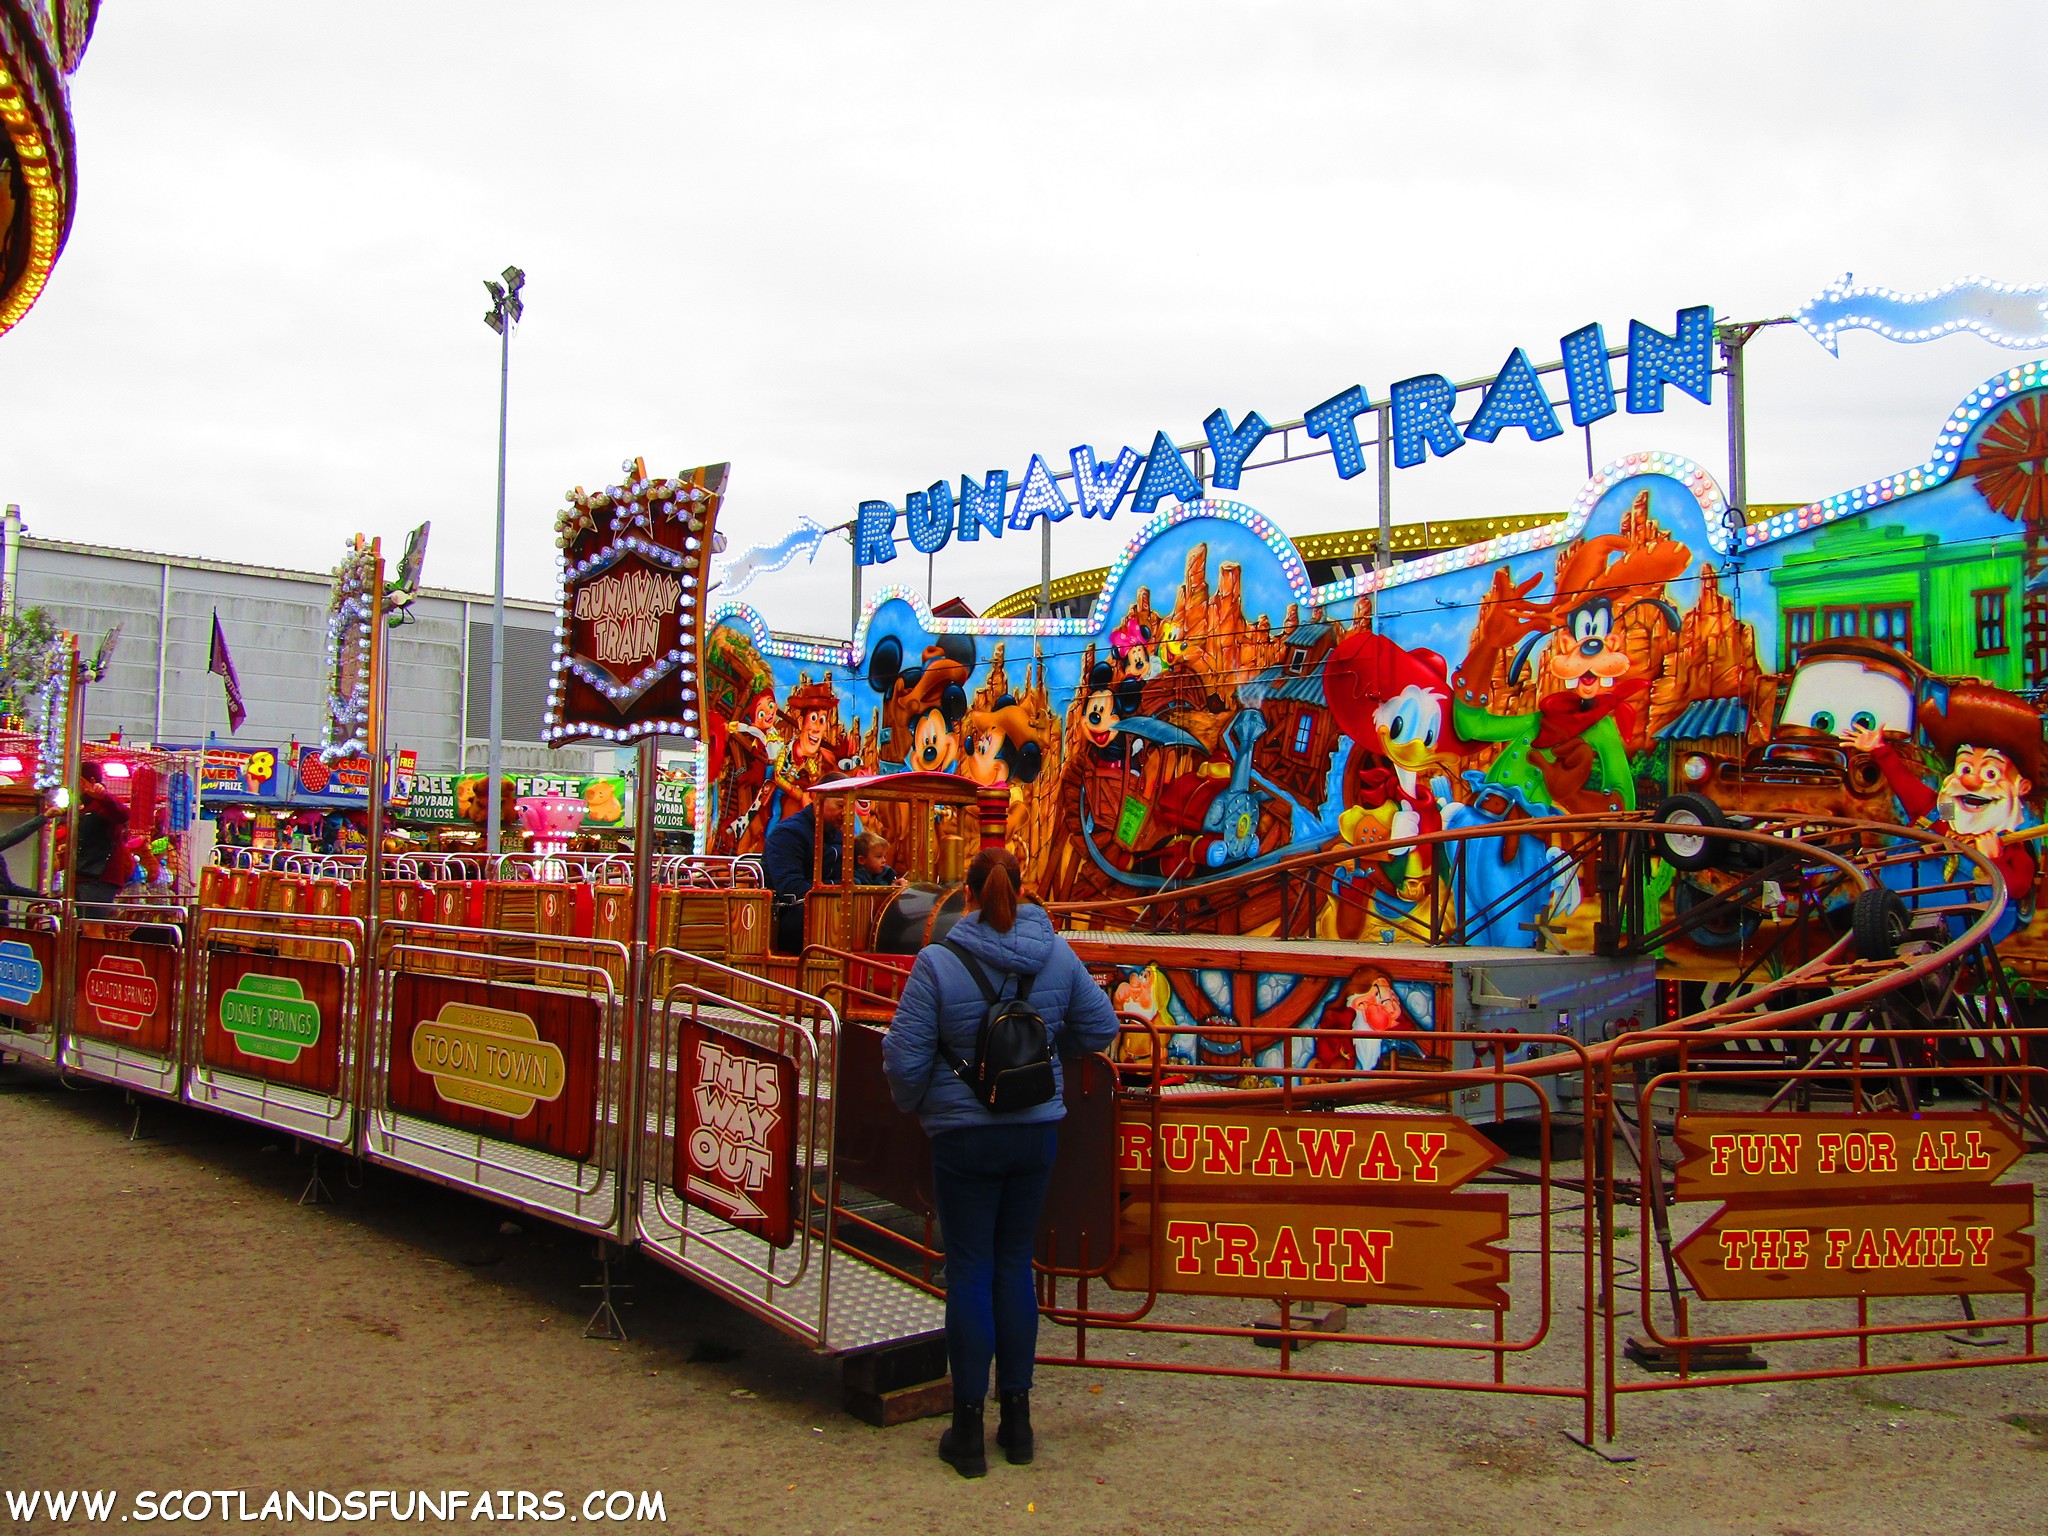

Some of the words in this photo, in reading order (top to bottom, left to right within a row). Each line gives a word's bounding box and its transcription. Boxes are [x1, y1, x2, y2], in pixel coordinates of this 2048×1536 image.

[857, 407, 1272, 566] RUNAWAY
[1304, 304, 1714, 480] TRAIN
[575, 569, 681, 621] RUNAWAY
[594, 615, 661, 665] TRAIN
[338, 772, 367, 786] OVER
[399, 757, 415, 768] FREE
[219, 781, 243, 791] PRIZE
[408, 795, 454, 807] APYBARA
[410, 775, 453, 795] FREE
[516, 778, 581, 798] FREE
[656, 783, 684, 803] REE
[415, 807, 432, 818] YOU
[434, 808, 454, 819] LOSE
[668, 816, 684, 826] LOSE
[91, 979, 122, 1001] RADIATOR
[123, 985, 152, 1006] SPRINGS
[227, 1001, 264, 1027] DISNEY
[267, 1008, 312, 1036] SPRINGS
[425, 1034, 478, 1072] TOON
[486, 1045, 547, 1088] TOWN
[697, 1040, 780, 1110] THIS
[692, 1085, 781, 1148] WAY
[689, 1126, 772, 1191] OUT
[1120, 1122, 1447, 1183] RUNAWAY
[1710, 1134, 1801, 1175] FUN
[1817, 1132, 1898, 1174] FOR
[1913, 1131, 1990, 1172] ALL
[1166, 1220, 1393, 1284] TRAIN
[1719, 1229, 1809, 1270] THE
[1825, 1226, 1994, 1269] FAMILY
